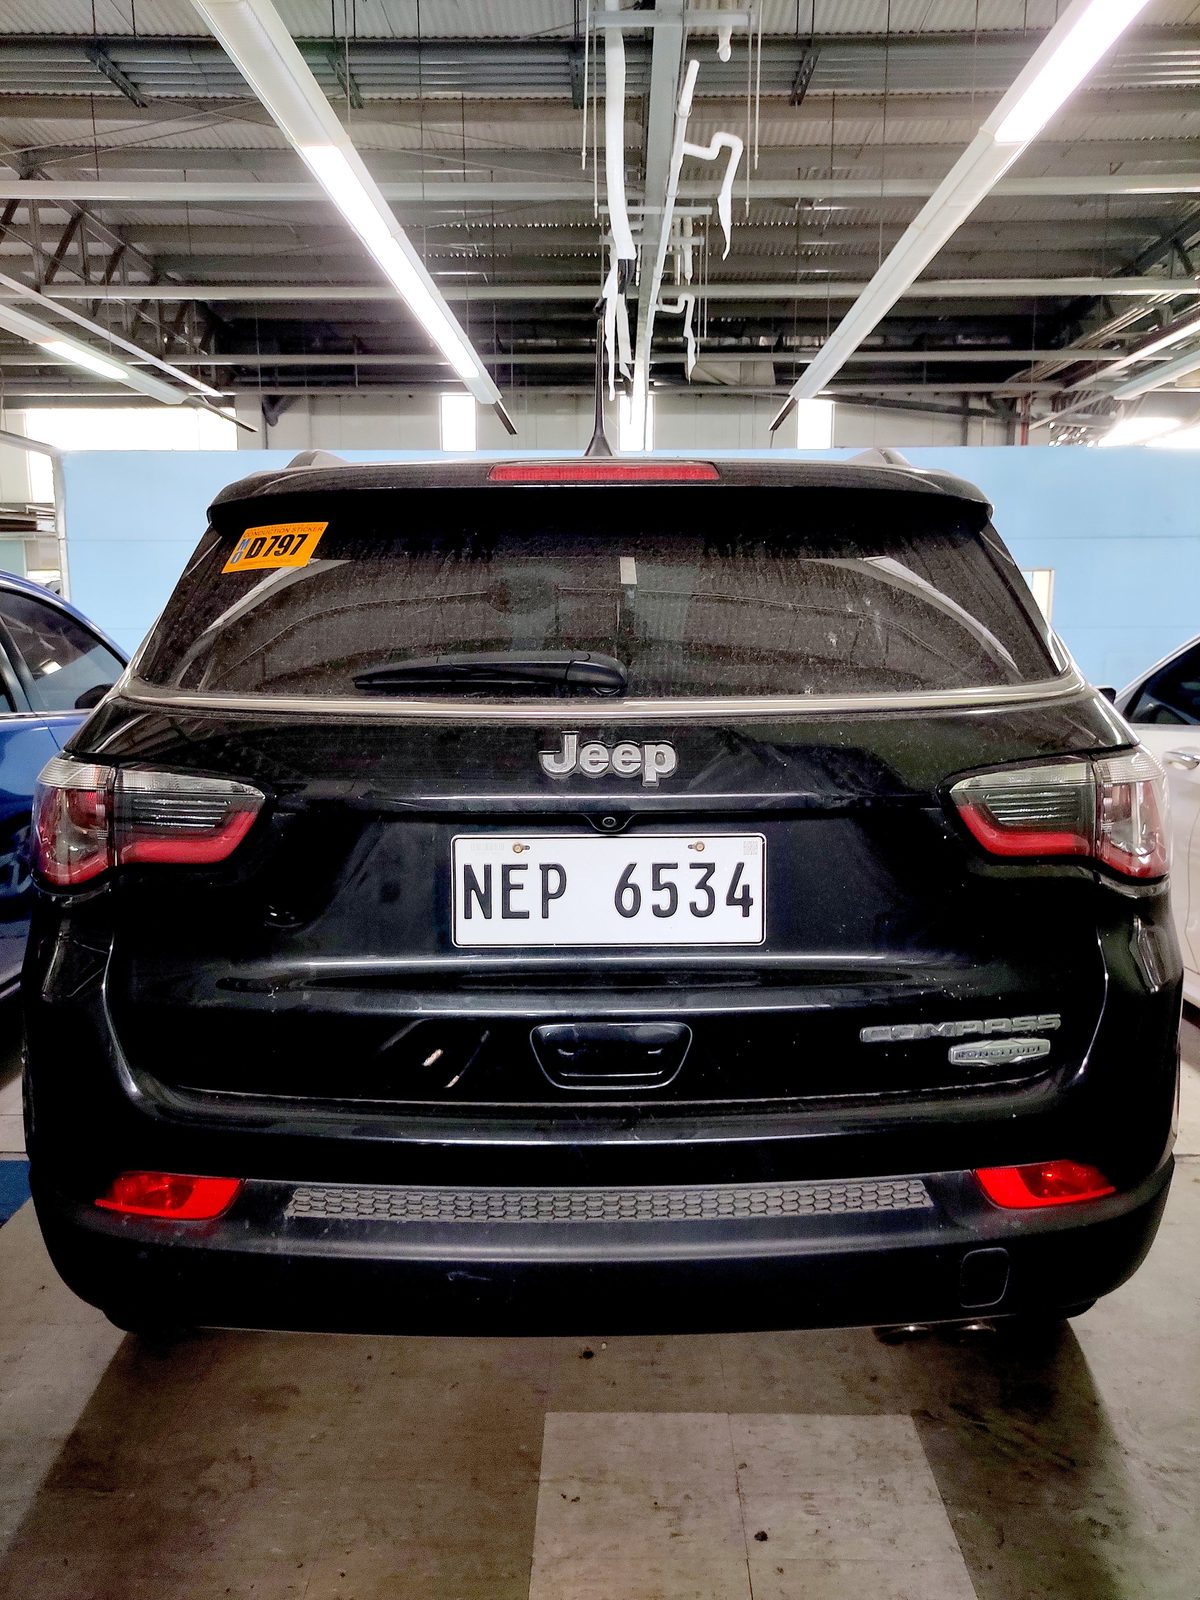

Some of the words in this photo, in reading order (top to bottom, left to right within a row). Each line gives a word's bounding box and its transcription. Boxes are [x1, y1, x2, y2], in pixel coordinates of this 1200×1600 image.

[291, 525, 324, 533] STICKER
[244, 533, 309, 560] D797
[538, 730, 678, 787] Jeep
[463, 863, 567, 919] NEP
[614, 862, 754, 918] 6534
[860, 1013, 1061, 1042] COMPASS
